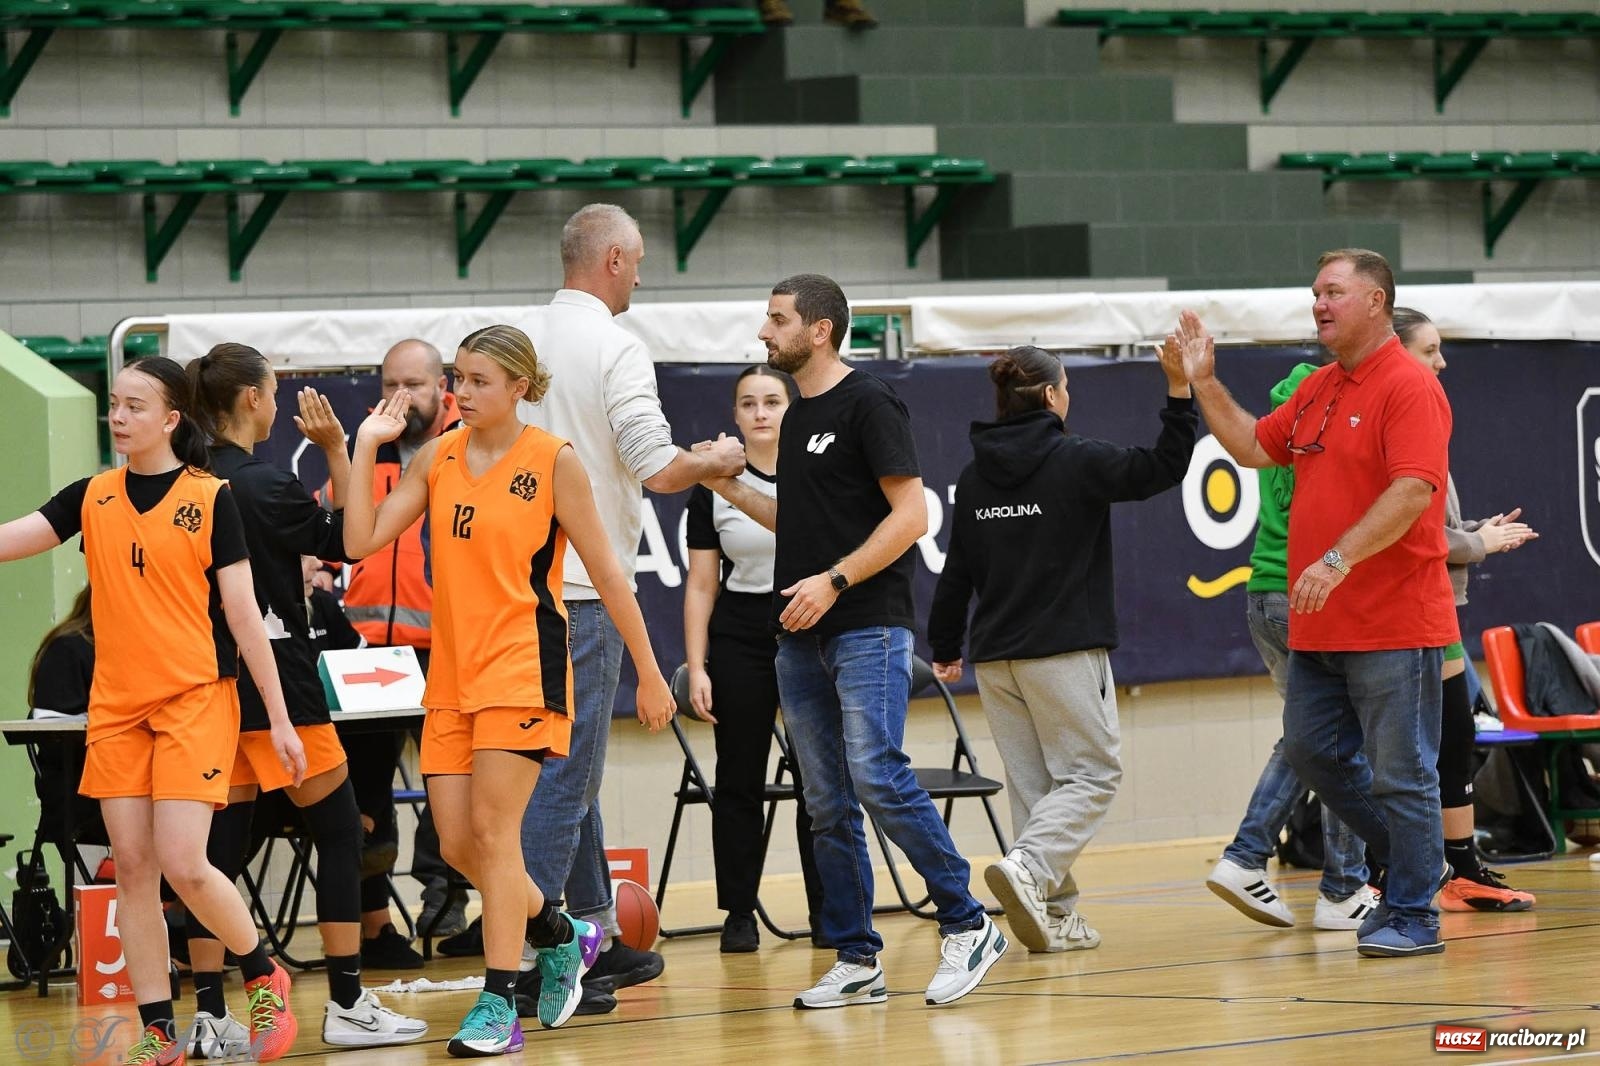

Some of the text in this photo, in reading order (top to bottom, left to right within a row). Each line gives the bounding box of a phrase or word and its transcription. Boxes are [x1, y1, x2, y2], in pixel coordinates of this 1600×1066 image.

[452, 503, 475, 540] 12
[975, 503, 1043, 520] KAROLINA
[131, 542, 145, 577] 4
